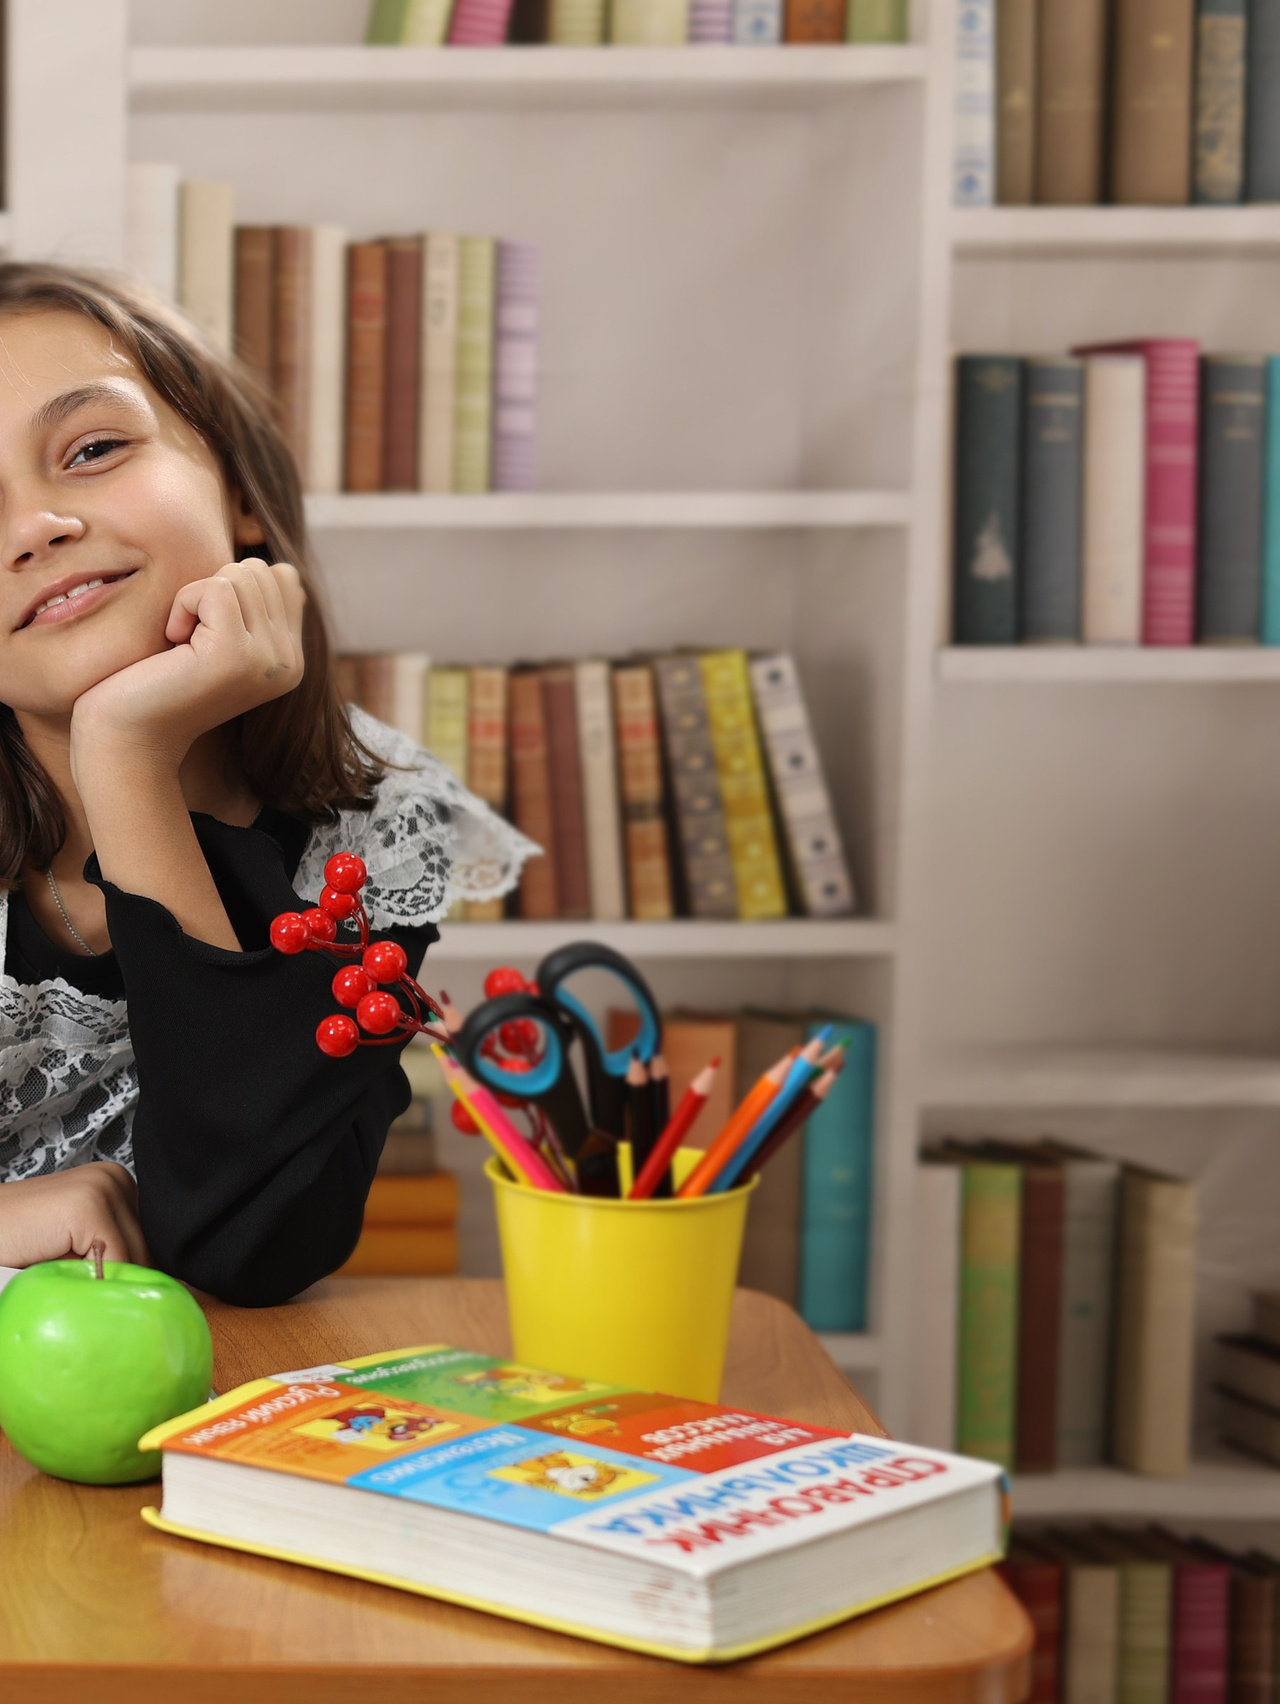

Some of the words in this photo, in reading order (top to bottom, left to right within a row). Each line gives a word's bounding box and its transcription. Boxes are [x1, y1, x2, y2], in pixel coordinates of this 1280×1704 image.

[239, 1383, 341, 1424] Русский
[182, 1418, 248, 1446] язык
[640, 1413, 757, 1445] КЛАССОВ
[642, 1420, 789, 1462] НАЧАЛЬНЫХ
[755, 1427, 814, 1446] ДЛЯ
[588, 1442, 897, 1536] ШКОЛЬНИКА
[645, 1456, 948, 1553] СПРАВОЧНИК
